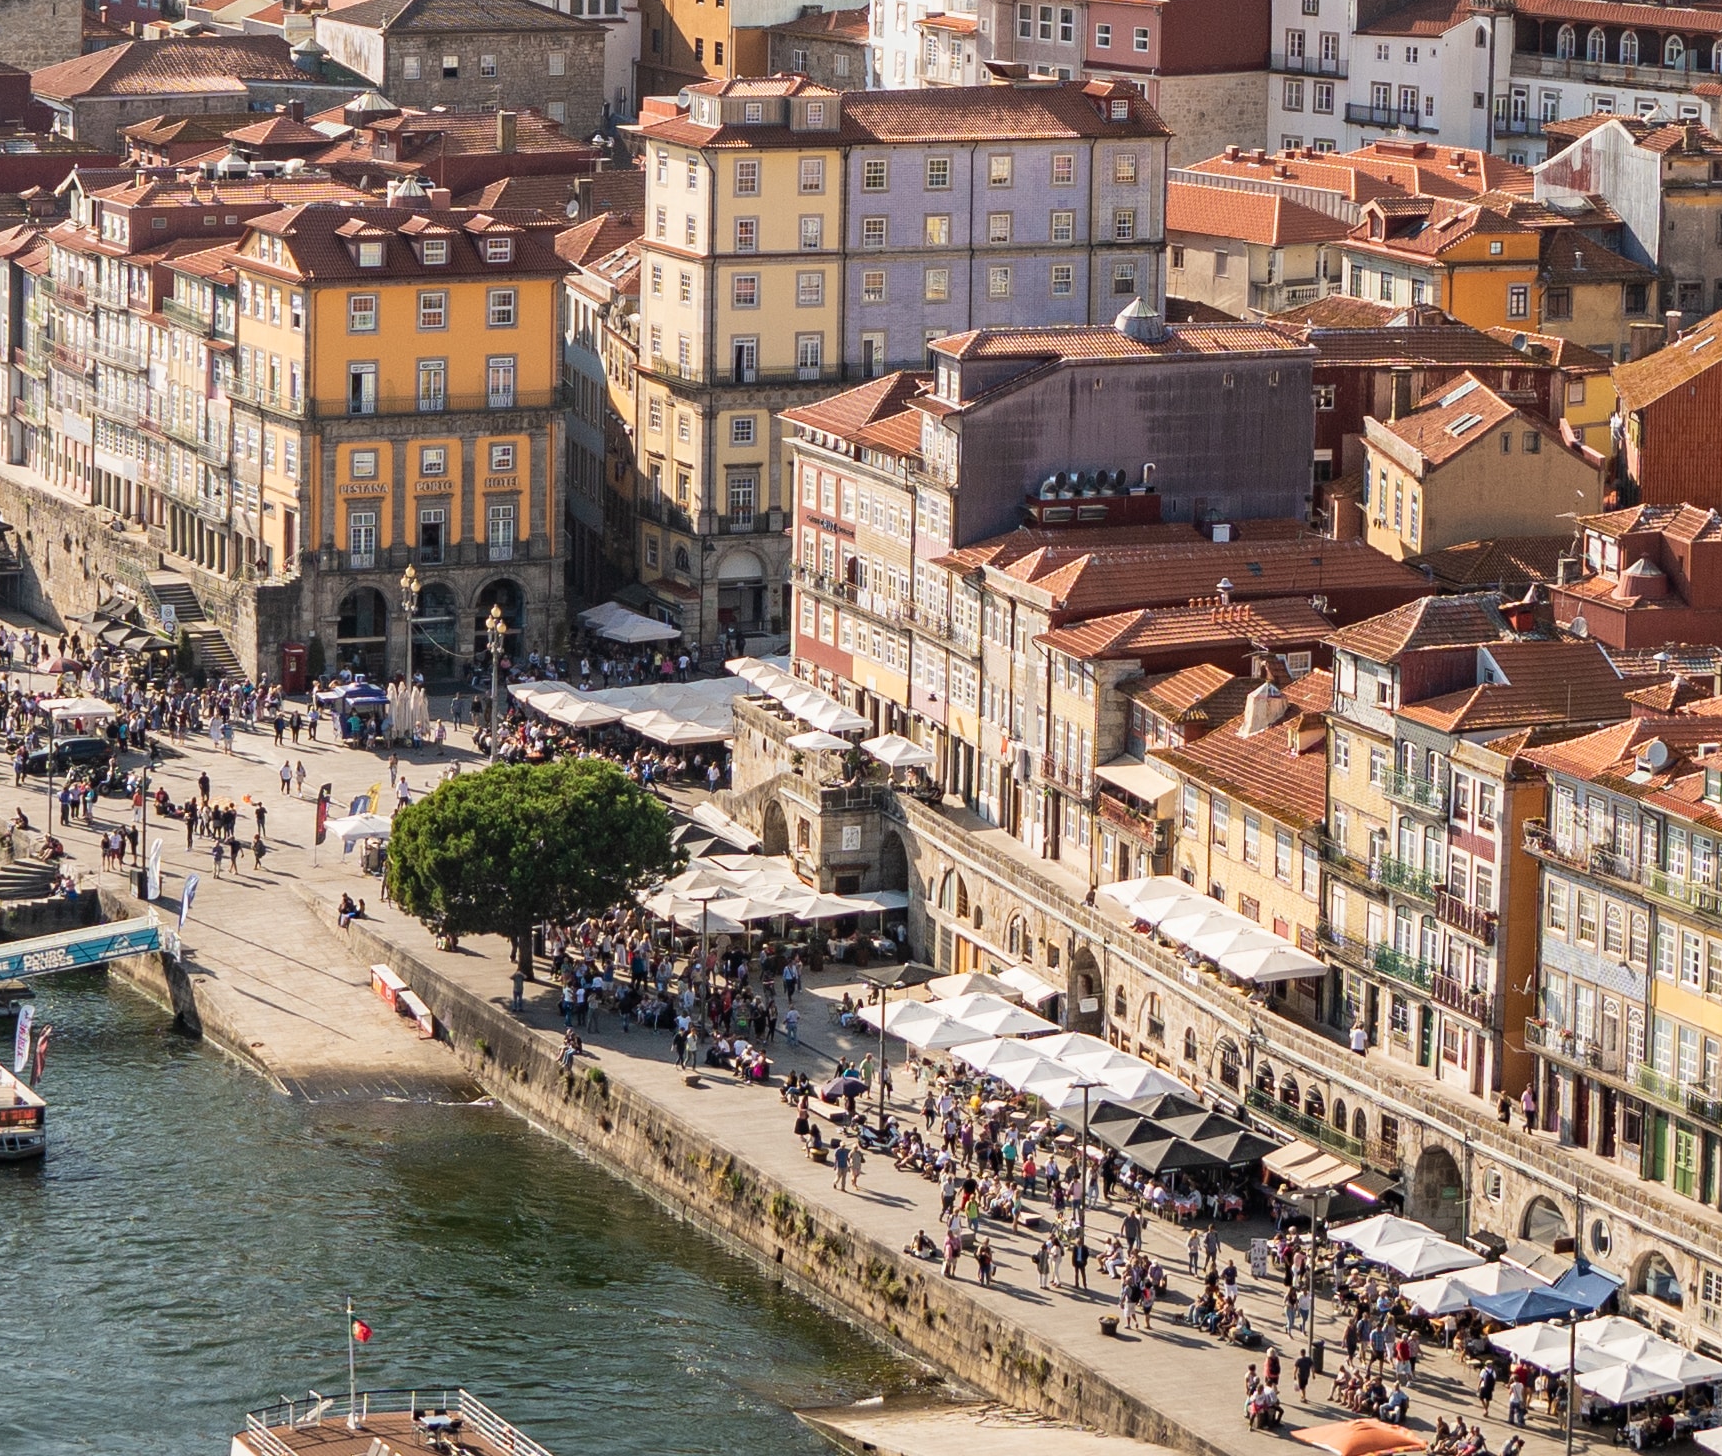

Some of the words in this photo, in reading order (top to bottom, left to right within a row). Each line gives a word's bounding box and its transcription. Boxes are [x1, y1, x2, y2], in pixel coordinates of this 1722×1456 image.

[340, 482, 389, 495] PESTANA
[415, 480, 454, 492] PORTO
[485, 476, 519, 488] HOTEL
[23, 948, 66, 963] DOURO
